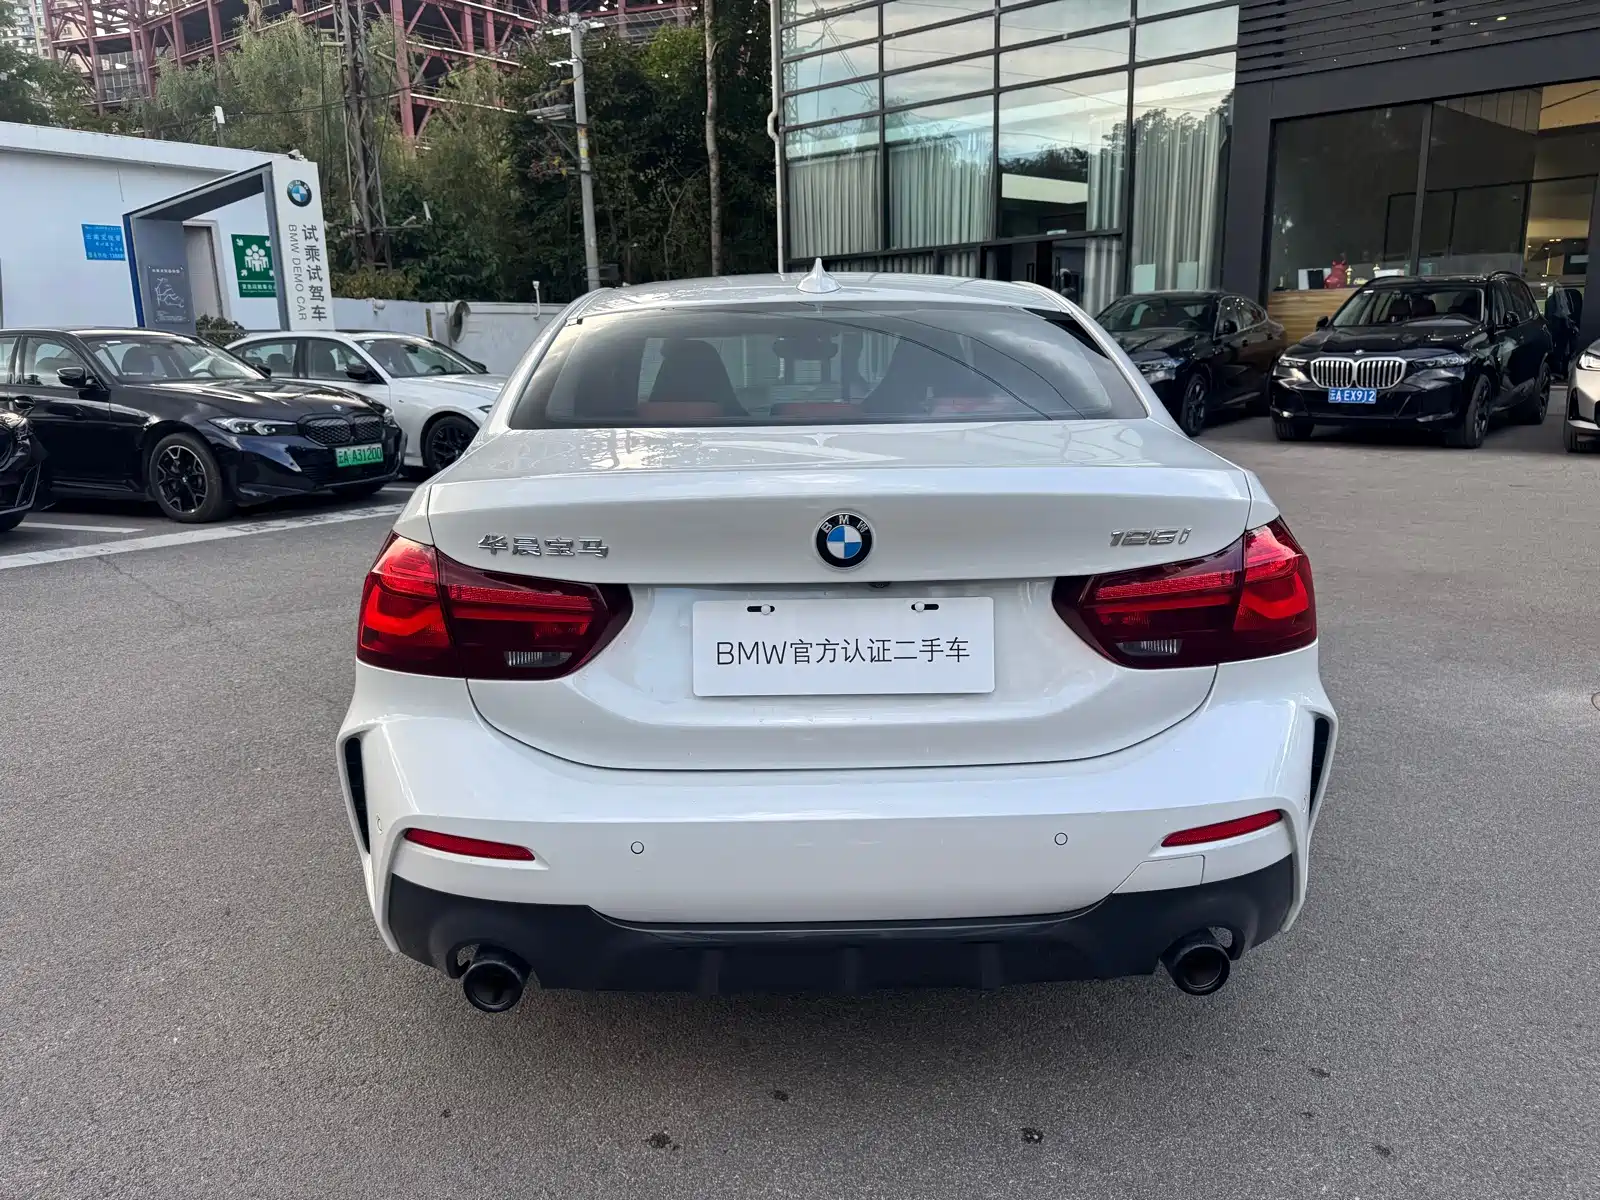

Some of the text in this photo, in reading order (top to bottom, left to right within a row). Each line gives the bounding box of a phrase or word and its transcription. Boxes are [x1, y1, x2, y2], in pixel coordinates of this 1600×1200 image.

[289, 224, 307, 321] BMW DEMO CAR
[302, 224, 327, 321] 试乘试驾车
[821, 514, 868, 533] BMW
[478, 534, 609, 558] 华晨宝马
[716, 636, 970, 665] BMW官方认证二手车
